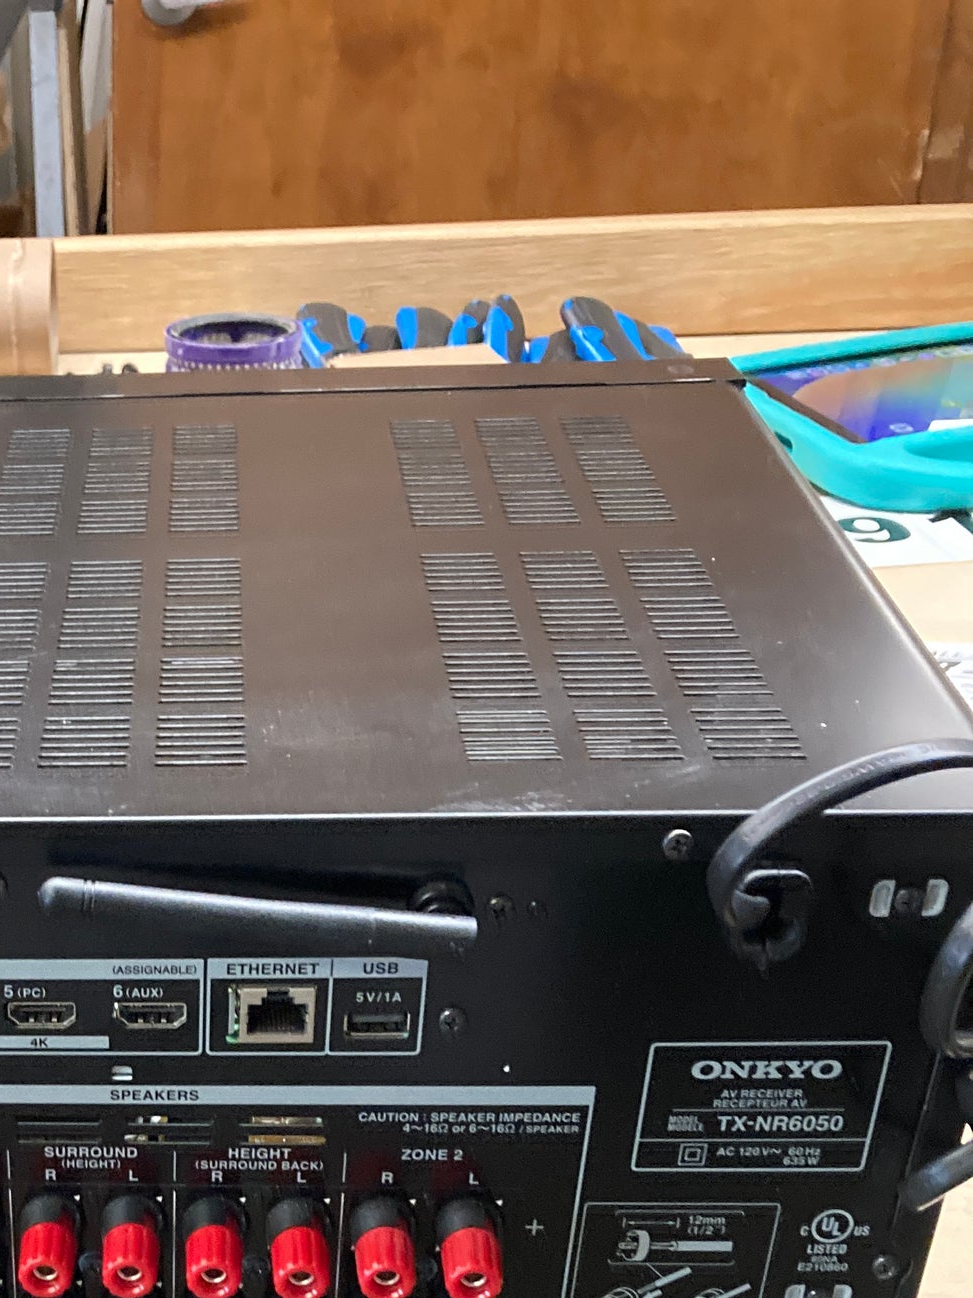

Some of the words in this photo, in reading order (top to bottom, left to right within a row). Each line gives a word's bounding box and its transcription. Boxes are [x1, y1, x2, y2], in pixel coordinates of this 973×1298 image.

[112, 965, 197, 976] (ASSIGNABLE)
[226, 963, 320, 976] ETHERNET
[362, 962, 399, 974] USB
[3, 984, 14, 998] 5
[17, 987, 47, 999] (PC)
[112, 984, 123, 998] 6
[126, 987, 164, 999] (AUX)
[30, 1037, 49, 1048] 4K
[690, 1059, 843, 1080] ONKYO
[110, 1089, 200, 1102] SPEAKERS
[720, 1089, 738, 1099] AV
[740, 1089, 804, 1099] RECEIVER
[790, 1099, 808, 1108] AV
[358, 1112, 419, 1123] CAUTION
[430, 1112, 496, 1123] SPEAKER
[498, 1112, 581, 1123] IMPEDANCE
[717, 1115, 845, 1132] TX-NR6050
[452, 1125, 467, 1134] or
[526, 1125, 580, 1134] SPEAKER
[43, 1146, 138, 1159] SURROUND
[227, 1147, 292, 1160] HEIGHT
[400, 1149, 448, 1161] ZONE
[453, 1149, 464, 1161] 2
[716, 1147, 735, 1156] AC
[61, 1158, 122, 1170] (HEIGHT)
[195, 1159, 277, 1171] (SURROUND
[281, 1160, 325, 1172] BACK)
[44, 1168, 57, 1181] R
[128, 1169, 139, 1182] L
[210, 1170, 223, 1183] R
[296, 1170, 307, 1184] L
[381, 1171, 394, 1184] R
[468, 1171, 479, 1185] L
[688, 1215, 726, 1225] 12mm
[821, 1216, 842, 1237] UL
[852, 1225, 871, 1237] US
[806, 1243, 848, 1255] LISTED
